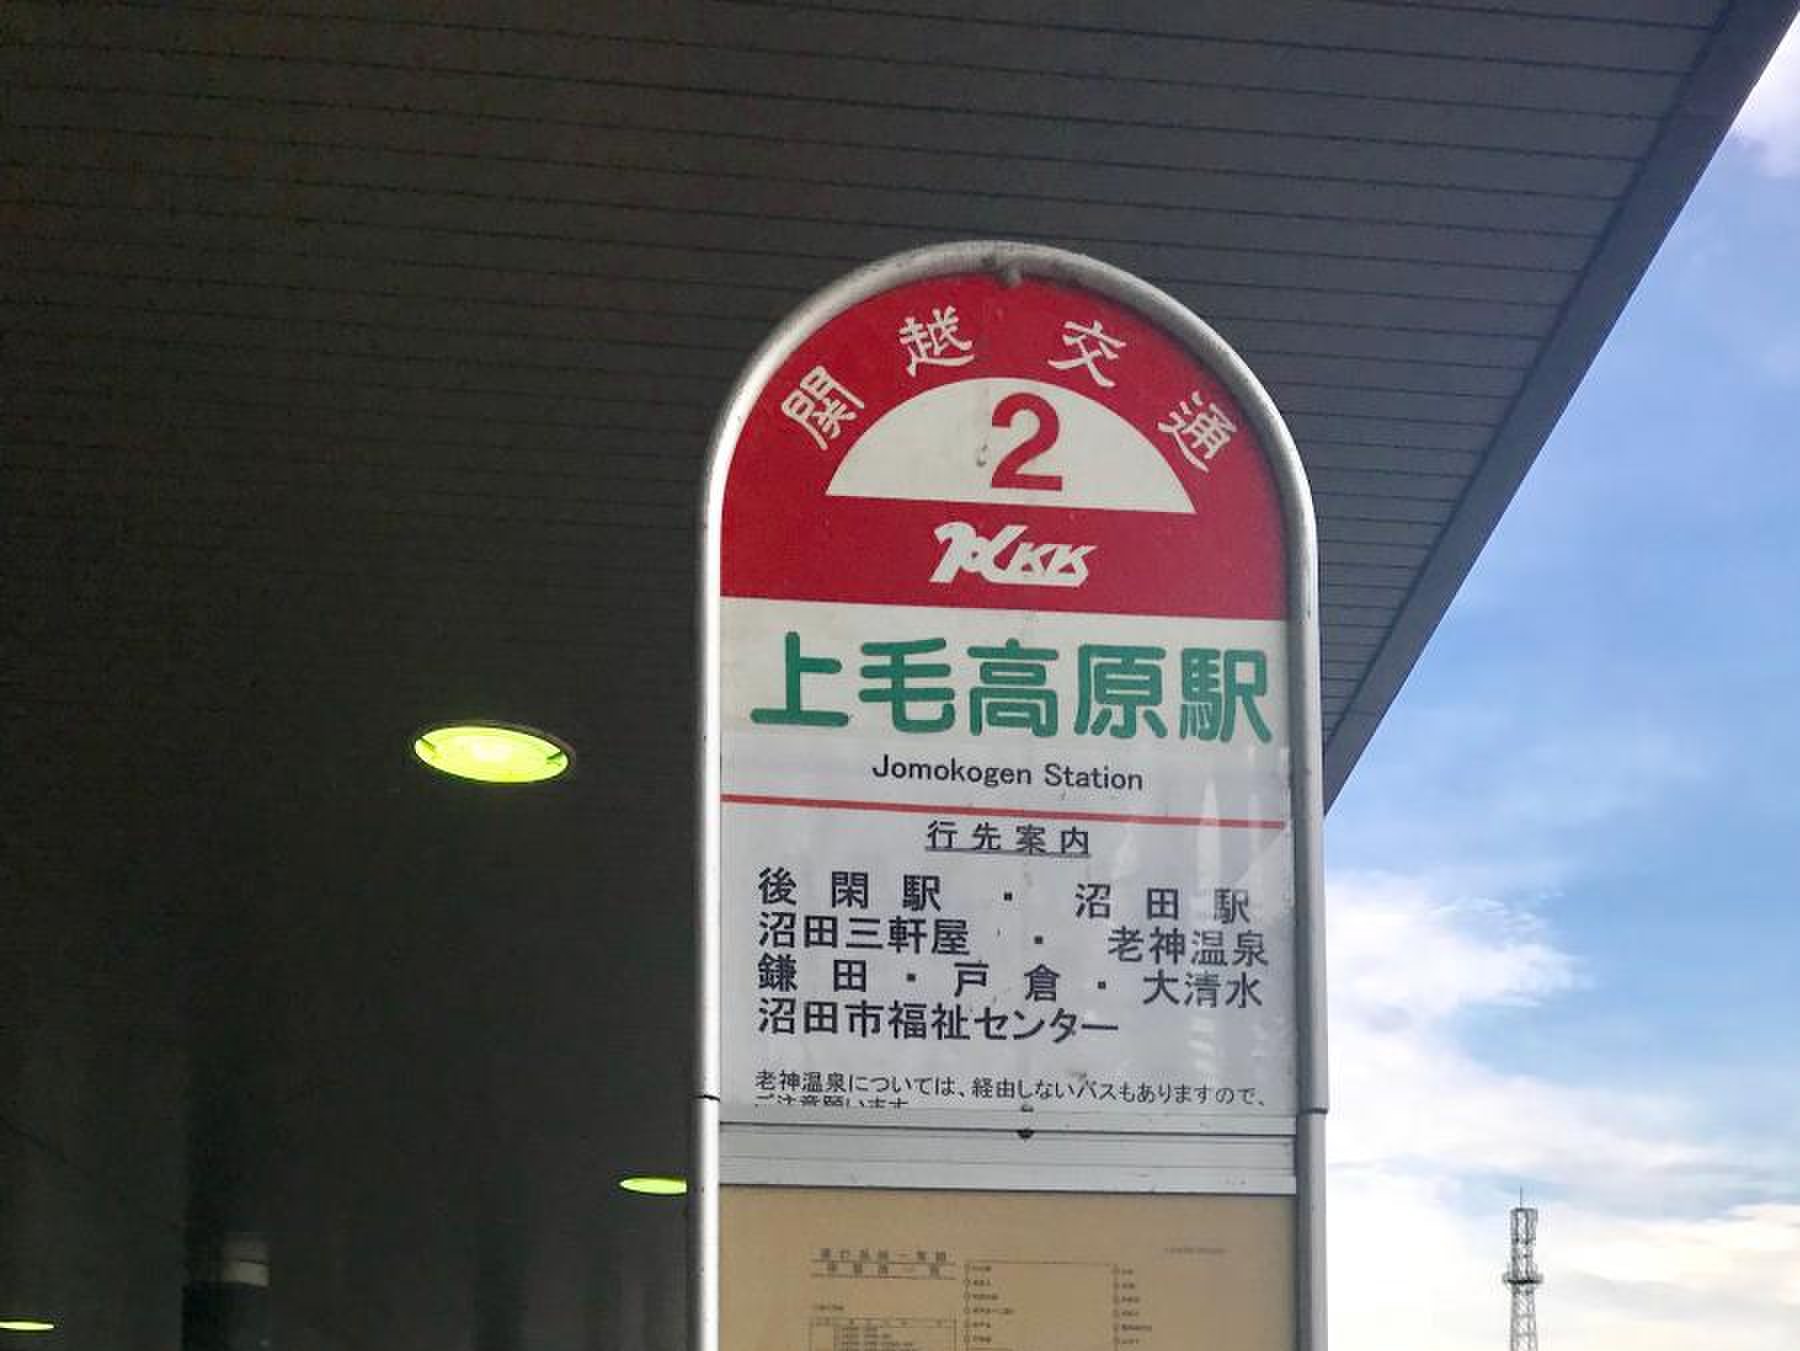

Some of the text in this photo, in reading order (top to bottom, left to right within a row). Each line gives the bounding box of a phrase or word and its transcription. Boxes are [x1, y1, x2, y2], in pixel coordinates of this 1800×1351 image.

[990, 393, 1062, 491] 2
[750, 632, 1272, 743] 上毛高原駅
[872, 754, 1142, 790] Jomokogen Station
[926, 819, 1090, 851] 行先案内
[758, 867, 941, 912] 後閑駅
[1075, 884, 1250, 925] 沼田駅
[759, 912, 969, 956] 沼田三軒屋
[1108, 927, 1268, 967] 老神温泉
[759, 996, 1118, 1043] 沼田市福祉センター
